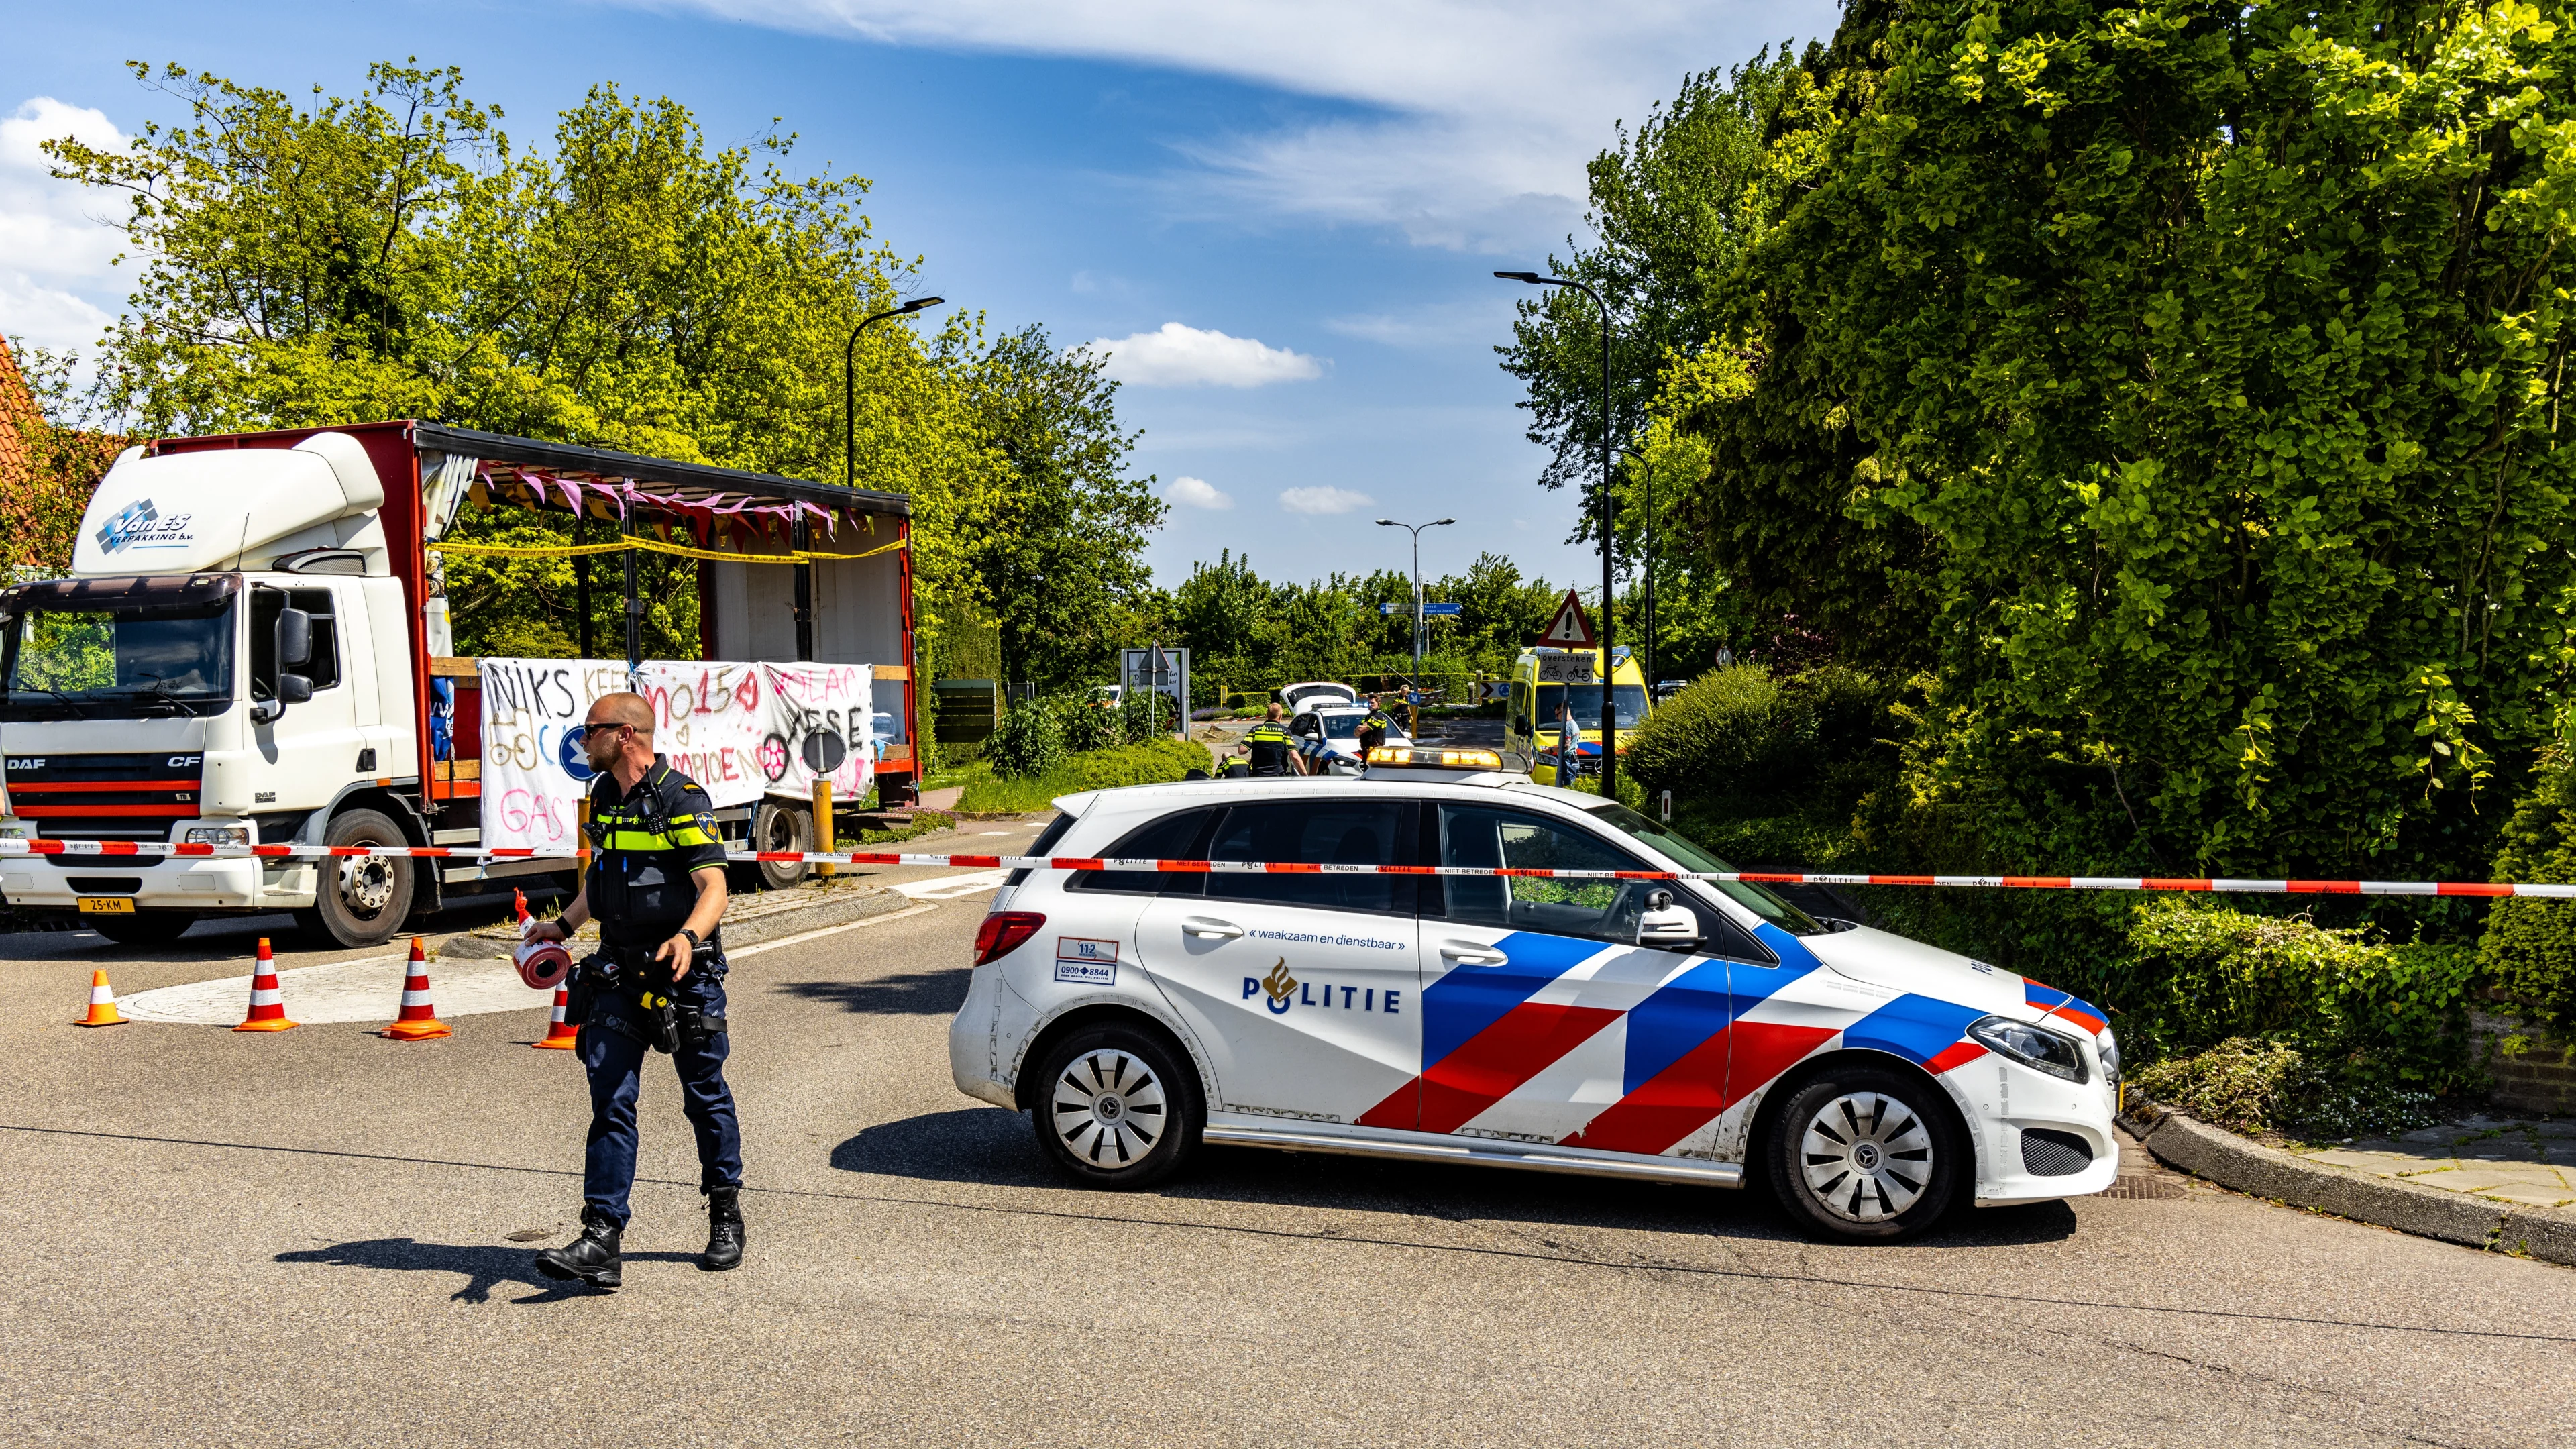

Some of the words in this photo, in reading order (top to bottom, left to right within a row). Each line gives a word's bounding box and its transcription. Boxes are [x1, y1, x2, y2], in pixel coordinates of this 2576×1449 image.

[113, 509, 157, 534] Van
[157, 513, 192, 531] ES
[110, 533, 176, 544] VERPAKKING
[1542, 655, 1591, 663] oversteken
[7, 759, 46, 769] DAF
[168, 756, 201, 767] CF
[500, 788, 564, 841] GAS
[91, 900, 121, 910] 25-KM
[1258, 930, 1318, 943] waakzaam
[1320, 935, 1334, 944] en
[1336, 934, 1397, 950] dienstbaar
[1061, 966, 1079, 974] 0900
[1089, 968, 1109, 977] 8844
[1242, 973, 1401, 1014] POLITIE
